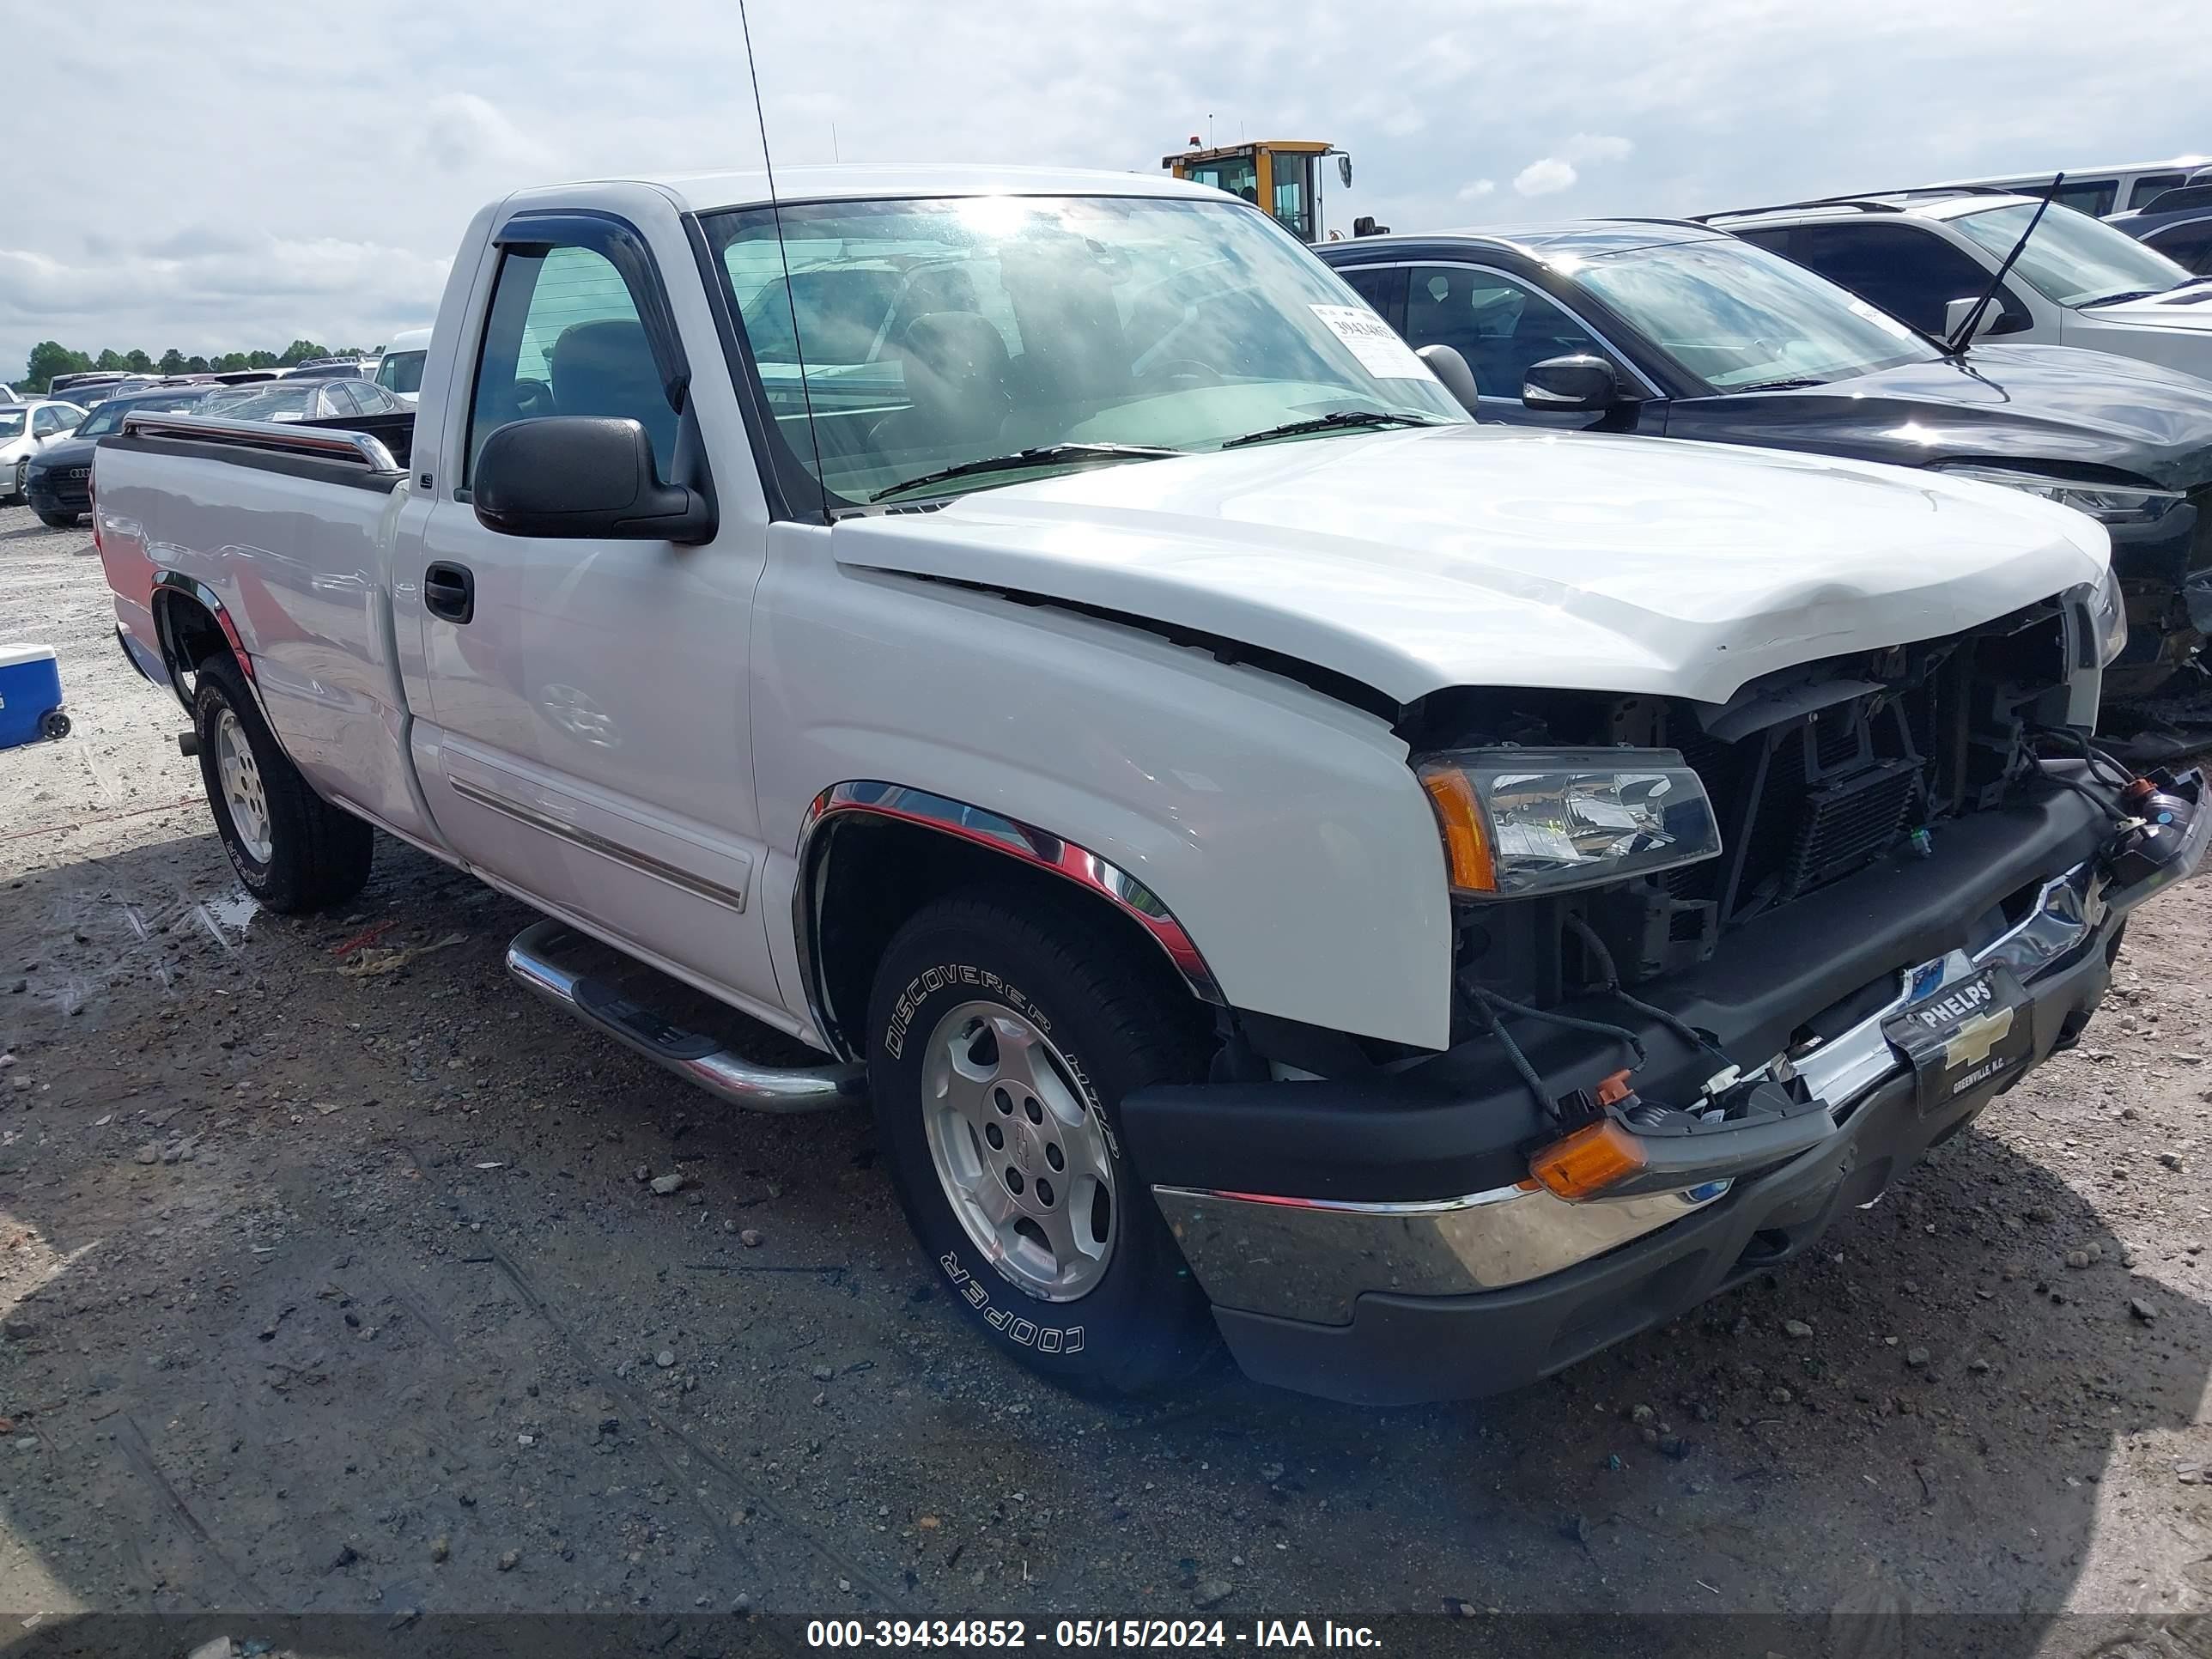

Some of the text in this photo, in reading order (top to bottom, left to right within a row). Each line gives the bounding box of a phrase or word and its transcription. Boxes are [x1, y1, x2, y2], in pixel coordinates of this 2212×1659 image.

[884, 963, 1053, 1060] DISCOVERER
[1920, 980, 1992, 1029] PHELPS
[1953, 1066, 1992, 1095] GREENVILLE,
[939, 1249, 1085, 1354] COOPER
